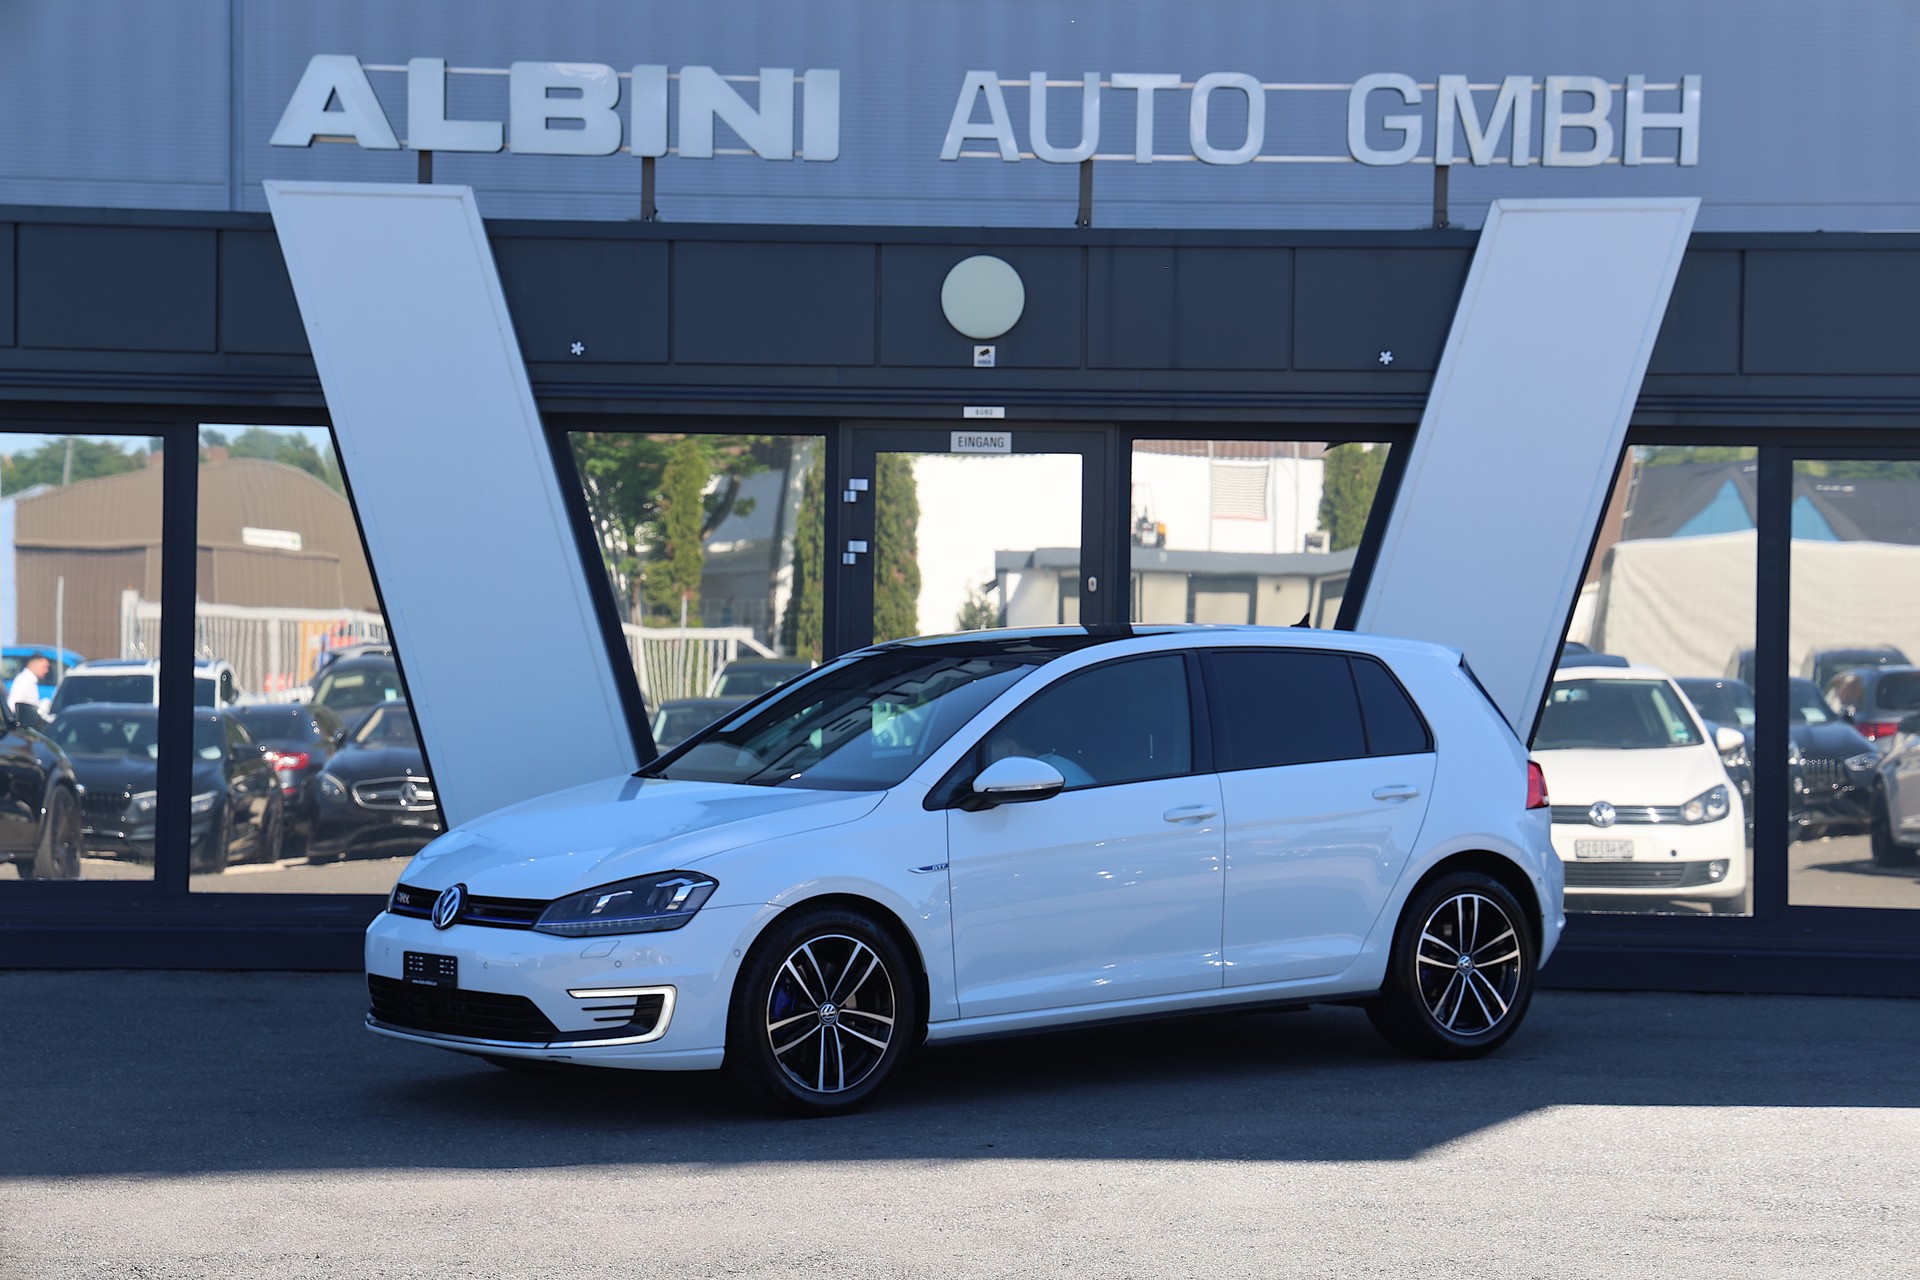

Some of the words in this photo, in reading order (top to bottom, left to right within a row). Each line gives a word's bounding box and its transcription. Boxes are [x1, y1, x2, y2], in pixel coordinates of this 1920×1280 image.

[269, 54, 840, 162] ALBINI
[940, 70, 1267, 166] AUTO
[1347, 72, 1702, 168] GMBH
[957, 436, 1004, 448] EINGANG
